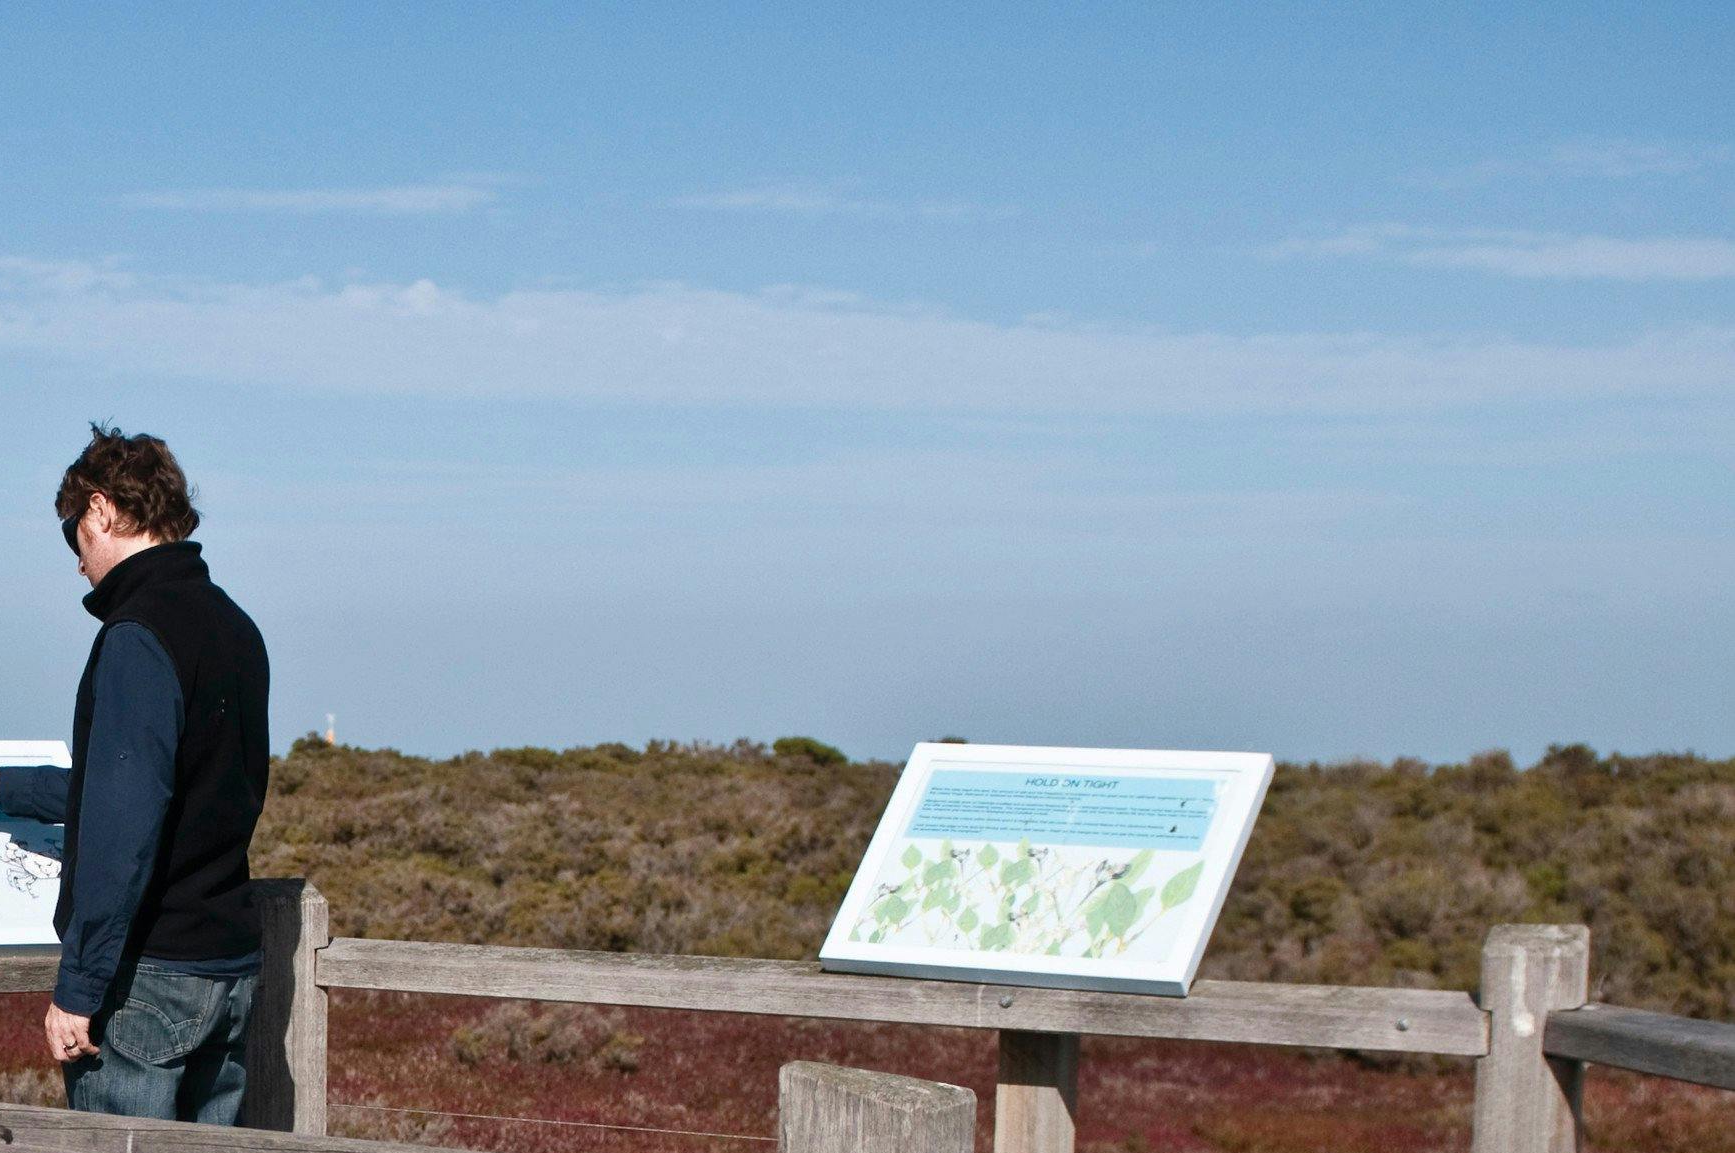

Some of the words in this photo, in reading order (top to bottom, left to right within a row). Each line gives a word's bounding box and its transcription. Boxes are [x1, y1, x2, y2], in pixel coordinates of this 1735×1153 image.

[1025, 778, 1059, 787] HOLD
[1061, 779, 1080, 788] ON
[1083, 780, 1120, 789] TIGHT
